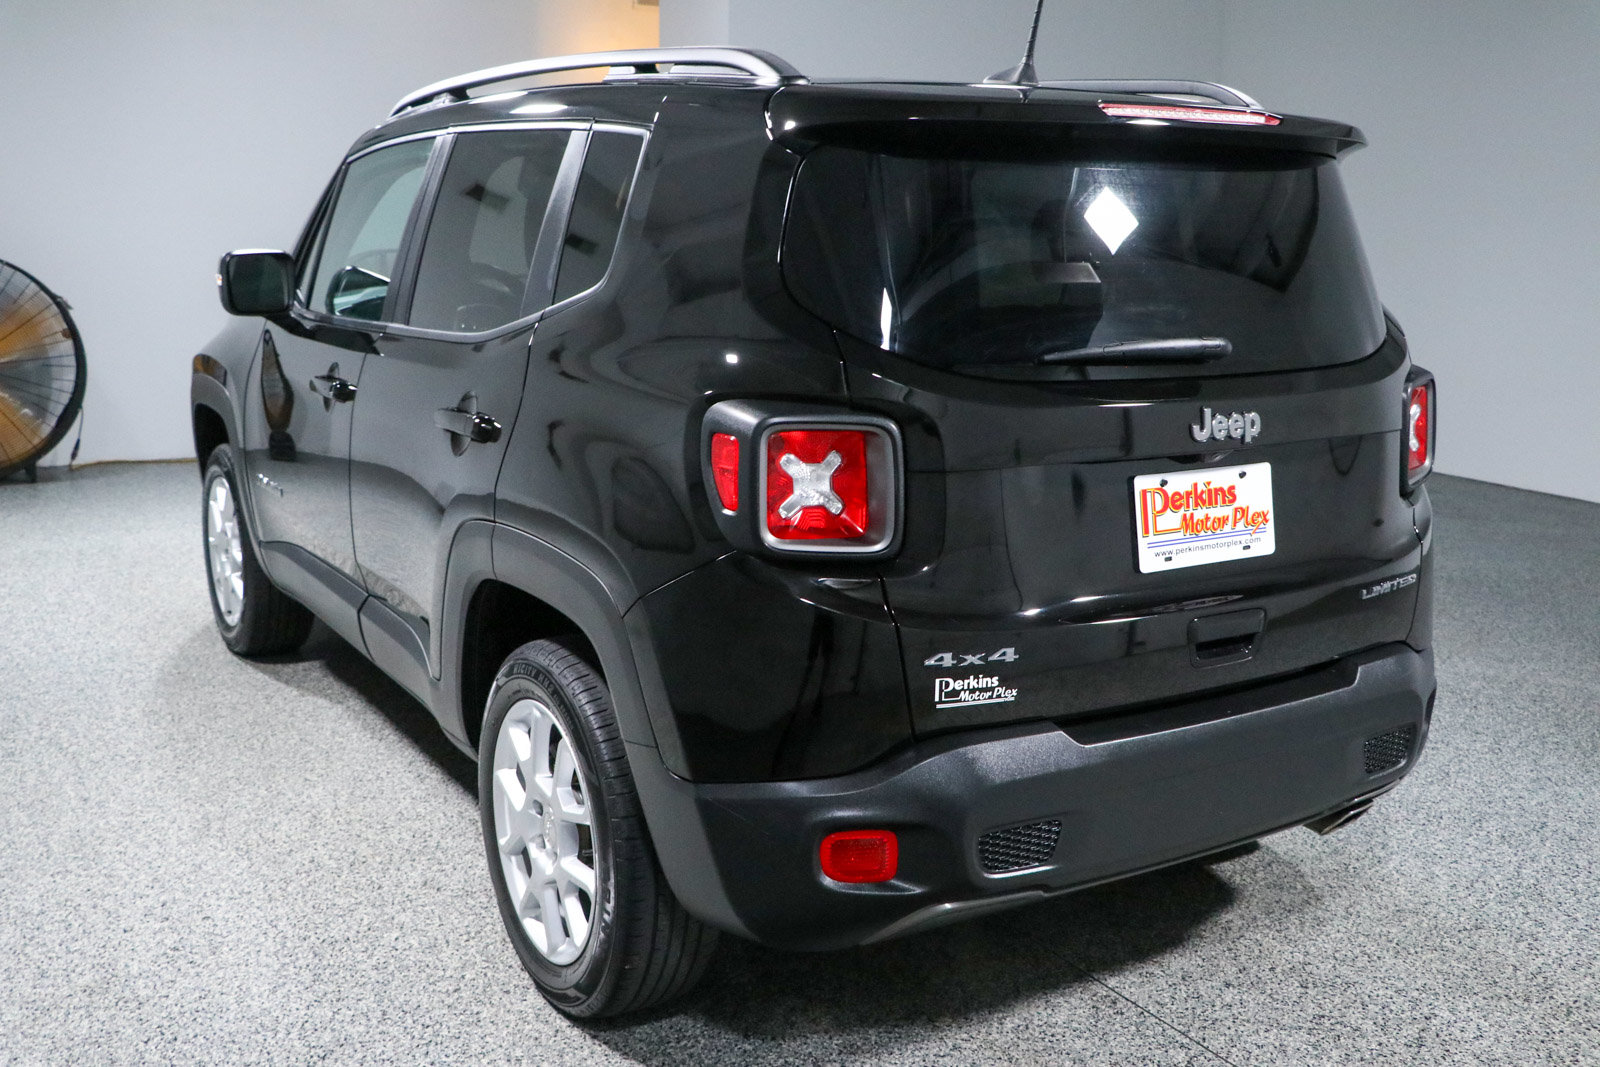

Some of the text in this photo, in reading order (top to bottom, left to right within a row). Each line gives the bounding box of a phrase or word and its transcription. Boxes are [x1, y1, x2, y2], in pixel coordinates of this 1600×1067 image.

[1190, 406, 1261, 443] Jeep
[1140, 481, 1237, 538] Perkins
[1181, 505, 1270, 536] Motor Plex
[1154, 536, 1262, 558] www.perkinsmotorplex.com
[1361, 573, 1417, 600] LIMITED
[934, 675, 999, 702] Perkins
[959, 687, 1018, 702] Motor Plex
